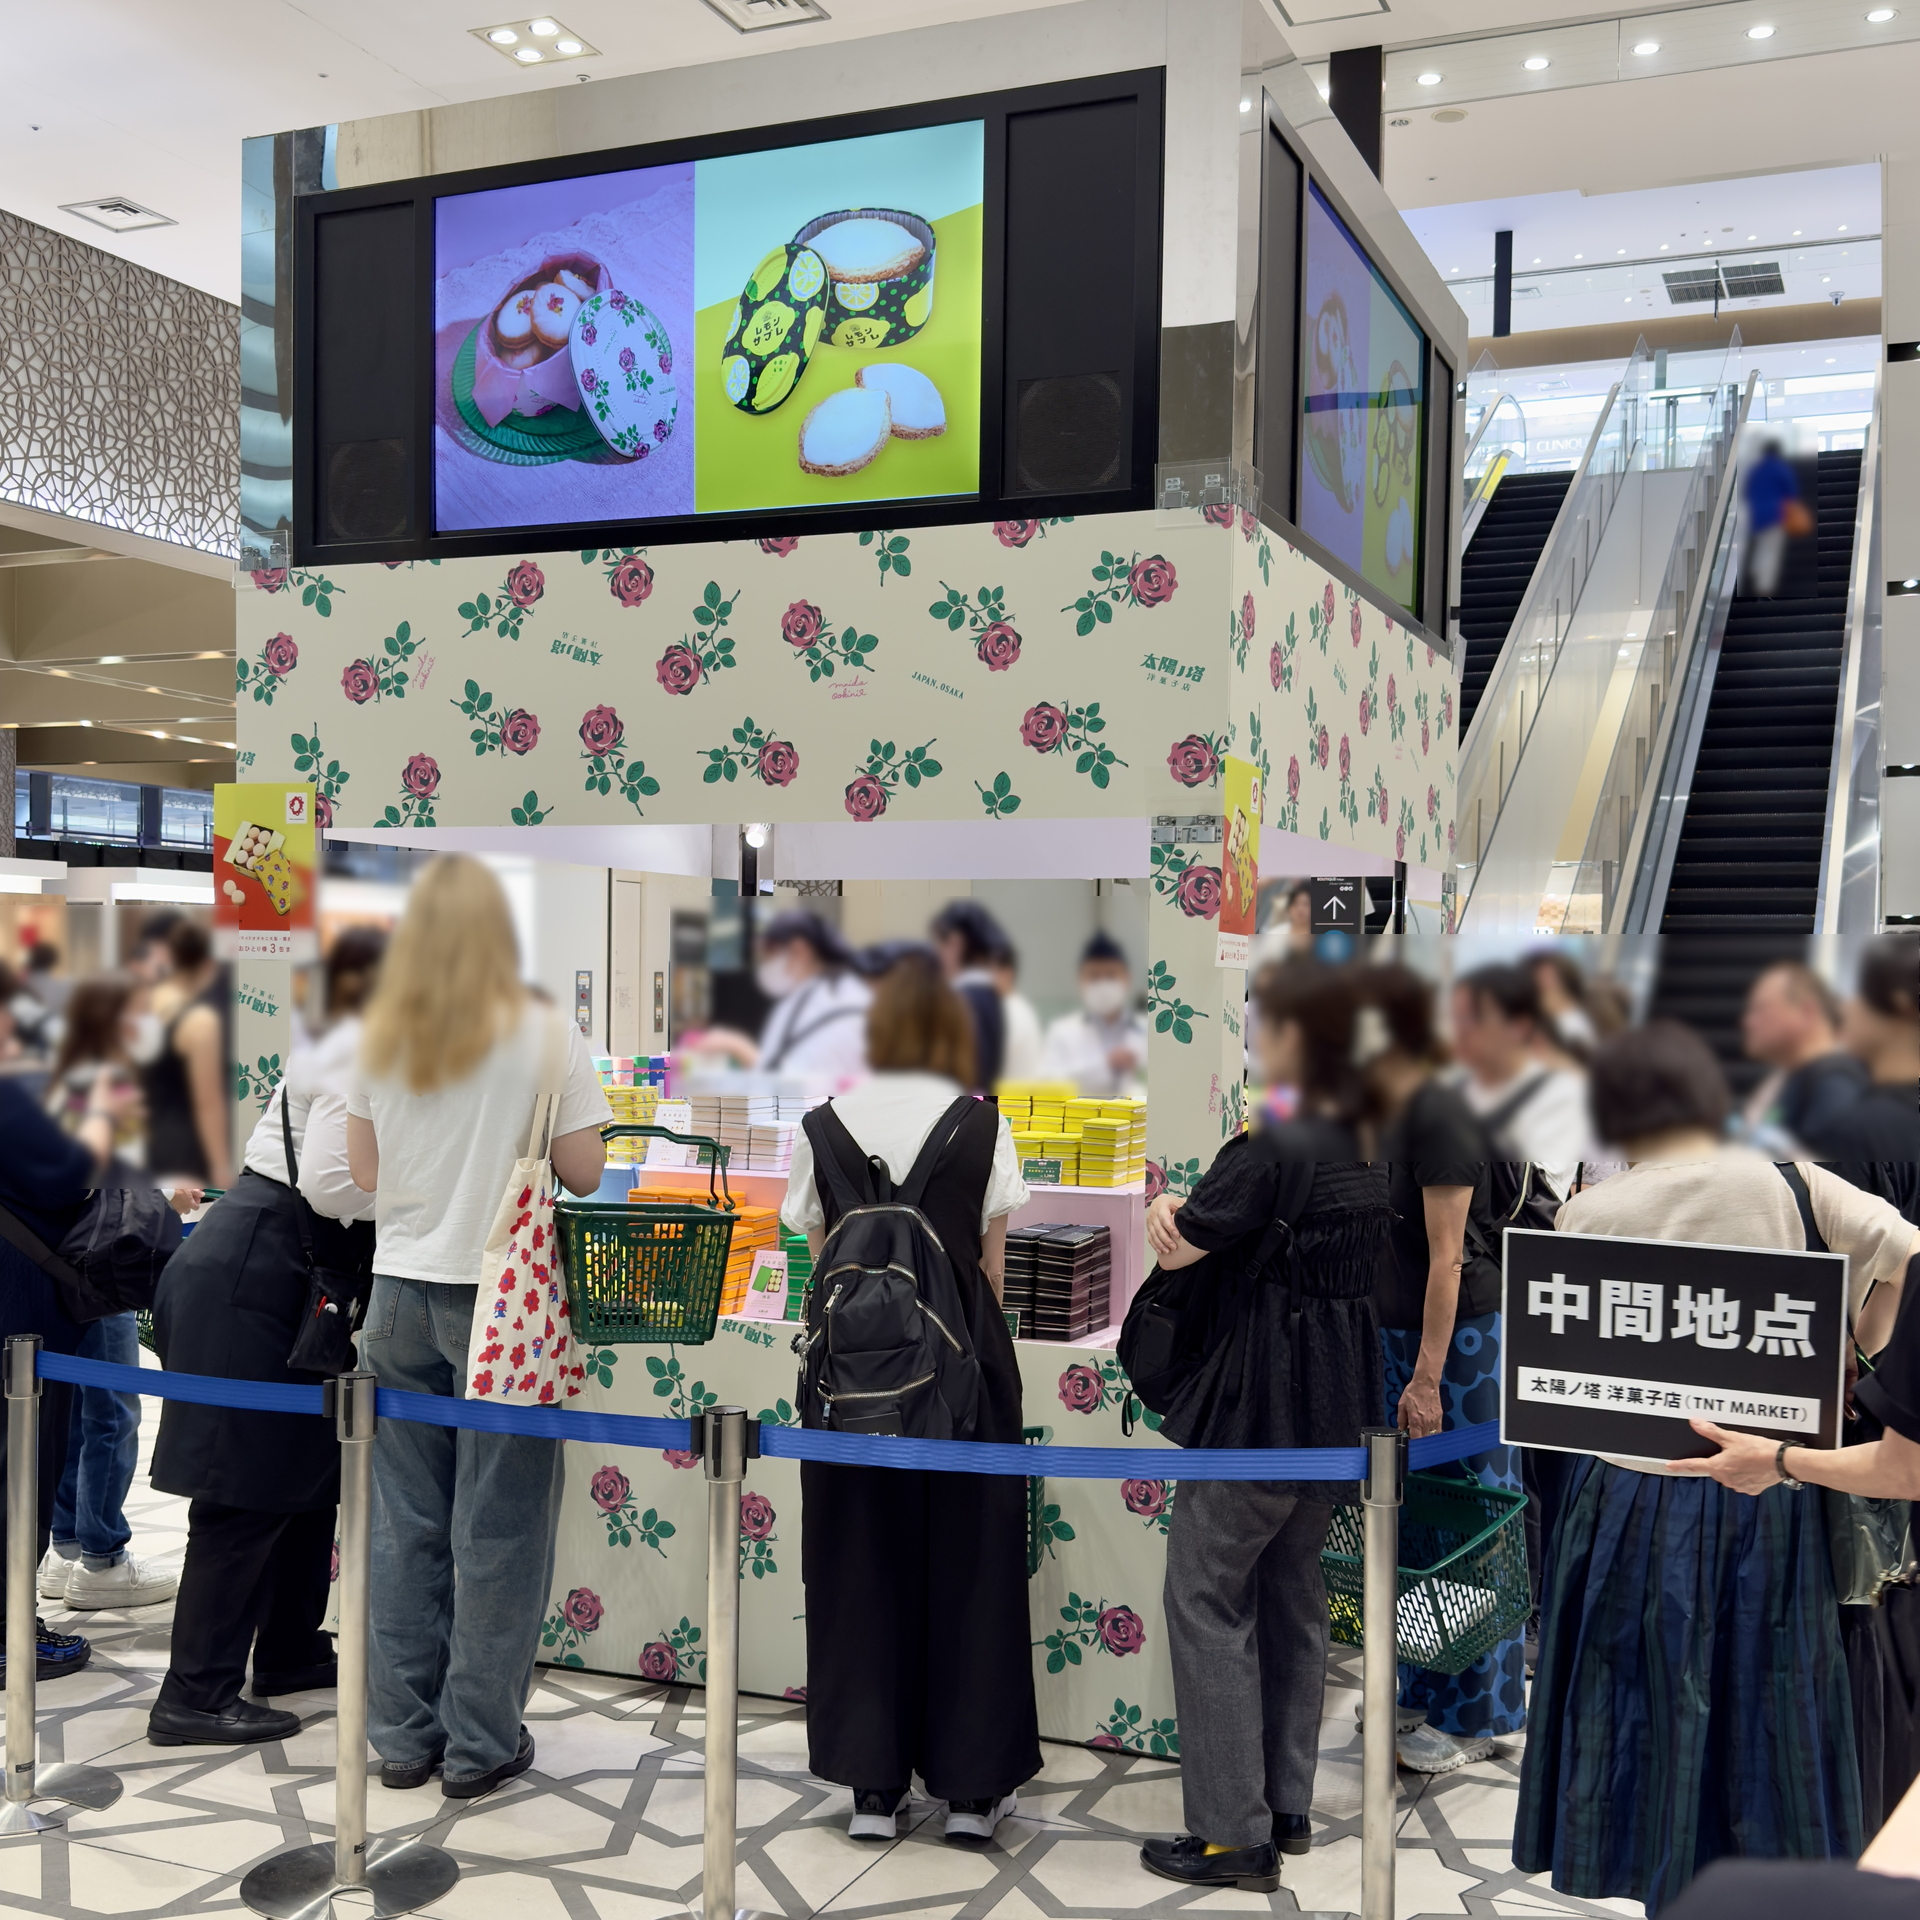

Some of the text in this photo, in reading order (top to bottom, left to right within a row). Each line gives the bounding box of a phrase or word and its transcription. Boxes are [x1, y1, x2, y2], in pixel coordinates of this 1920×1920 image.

[753, 327, 783, 346] サブレ
[755, 316, 781, 335] レモン
[845, 327, 872, 340] レモン
[550, 639, 603, 666] 太陽ノ塔
[1140, 653, 1206, 683] 太陽ノ塔
[911, 671, 964, 700] JAPAN, OSAKA
[1526, 1273, 1817, 1358] 中間地点
[1530, 1376, 1601, 1400] 太陽ノ塔
[1323, 1567, 1364, 1584] DAIMAR
